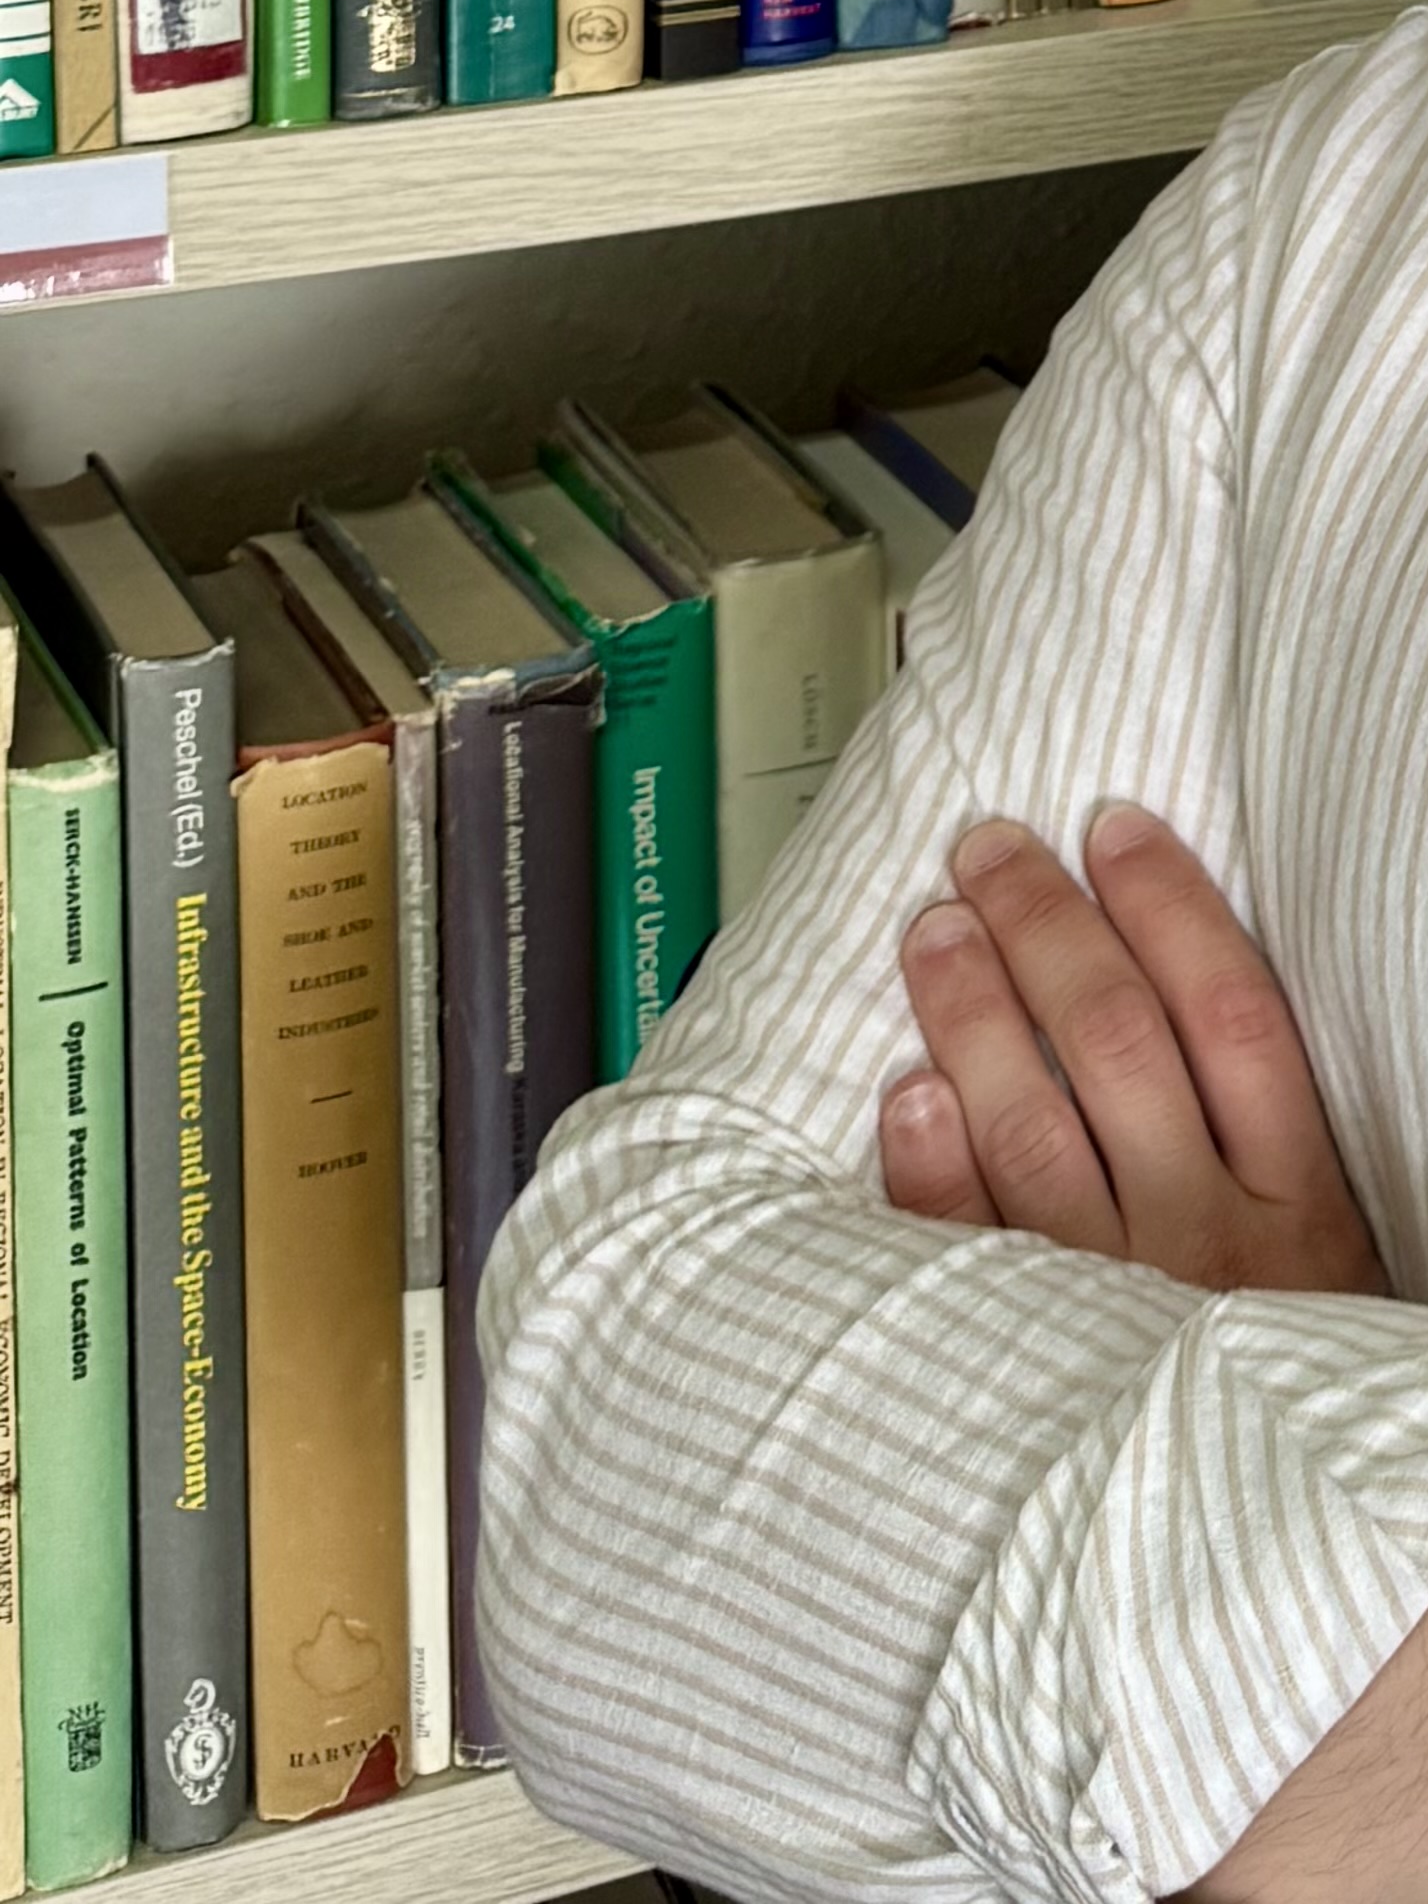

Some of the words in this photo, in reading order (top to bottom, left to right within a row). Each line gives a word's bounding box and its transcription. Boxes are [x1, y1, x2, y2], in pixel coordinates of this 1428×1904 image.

[174, 688, 203, 798] Peschel
[170, 800, 204, 869] (Ed.)
[175, 892, 209, 1116] Infrastructure
